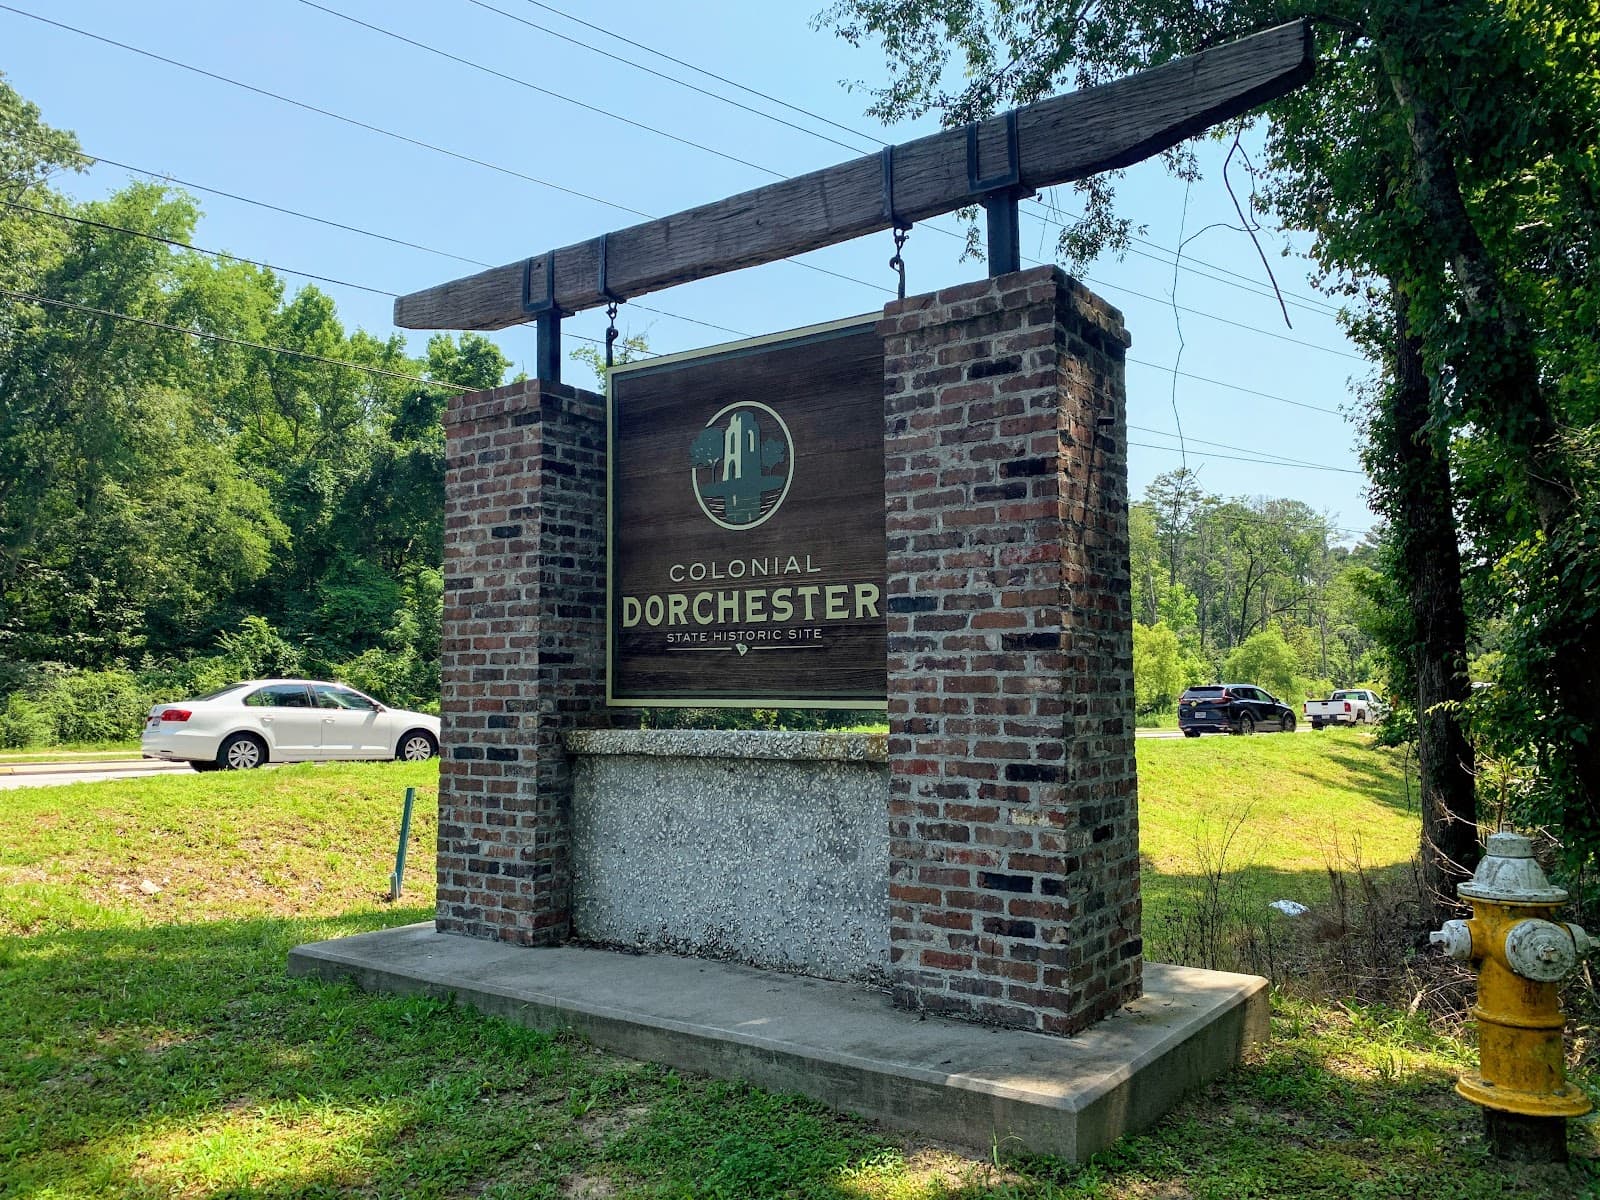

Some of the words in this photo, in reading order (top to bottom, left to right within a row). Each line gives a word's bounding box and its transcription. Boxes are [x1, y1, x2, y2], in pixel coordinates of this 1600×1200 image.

[669, 555, 821, 582] COLONIAL
[622, 583, 880, 628] DORCHESTER
[667, 631, 708, 643] STATE
[713, 630, 782, 641] HISTORIC
[788, 628, 823, 639] SITE
